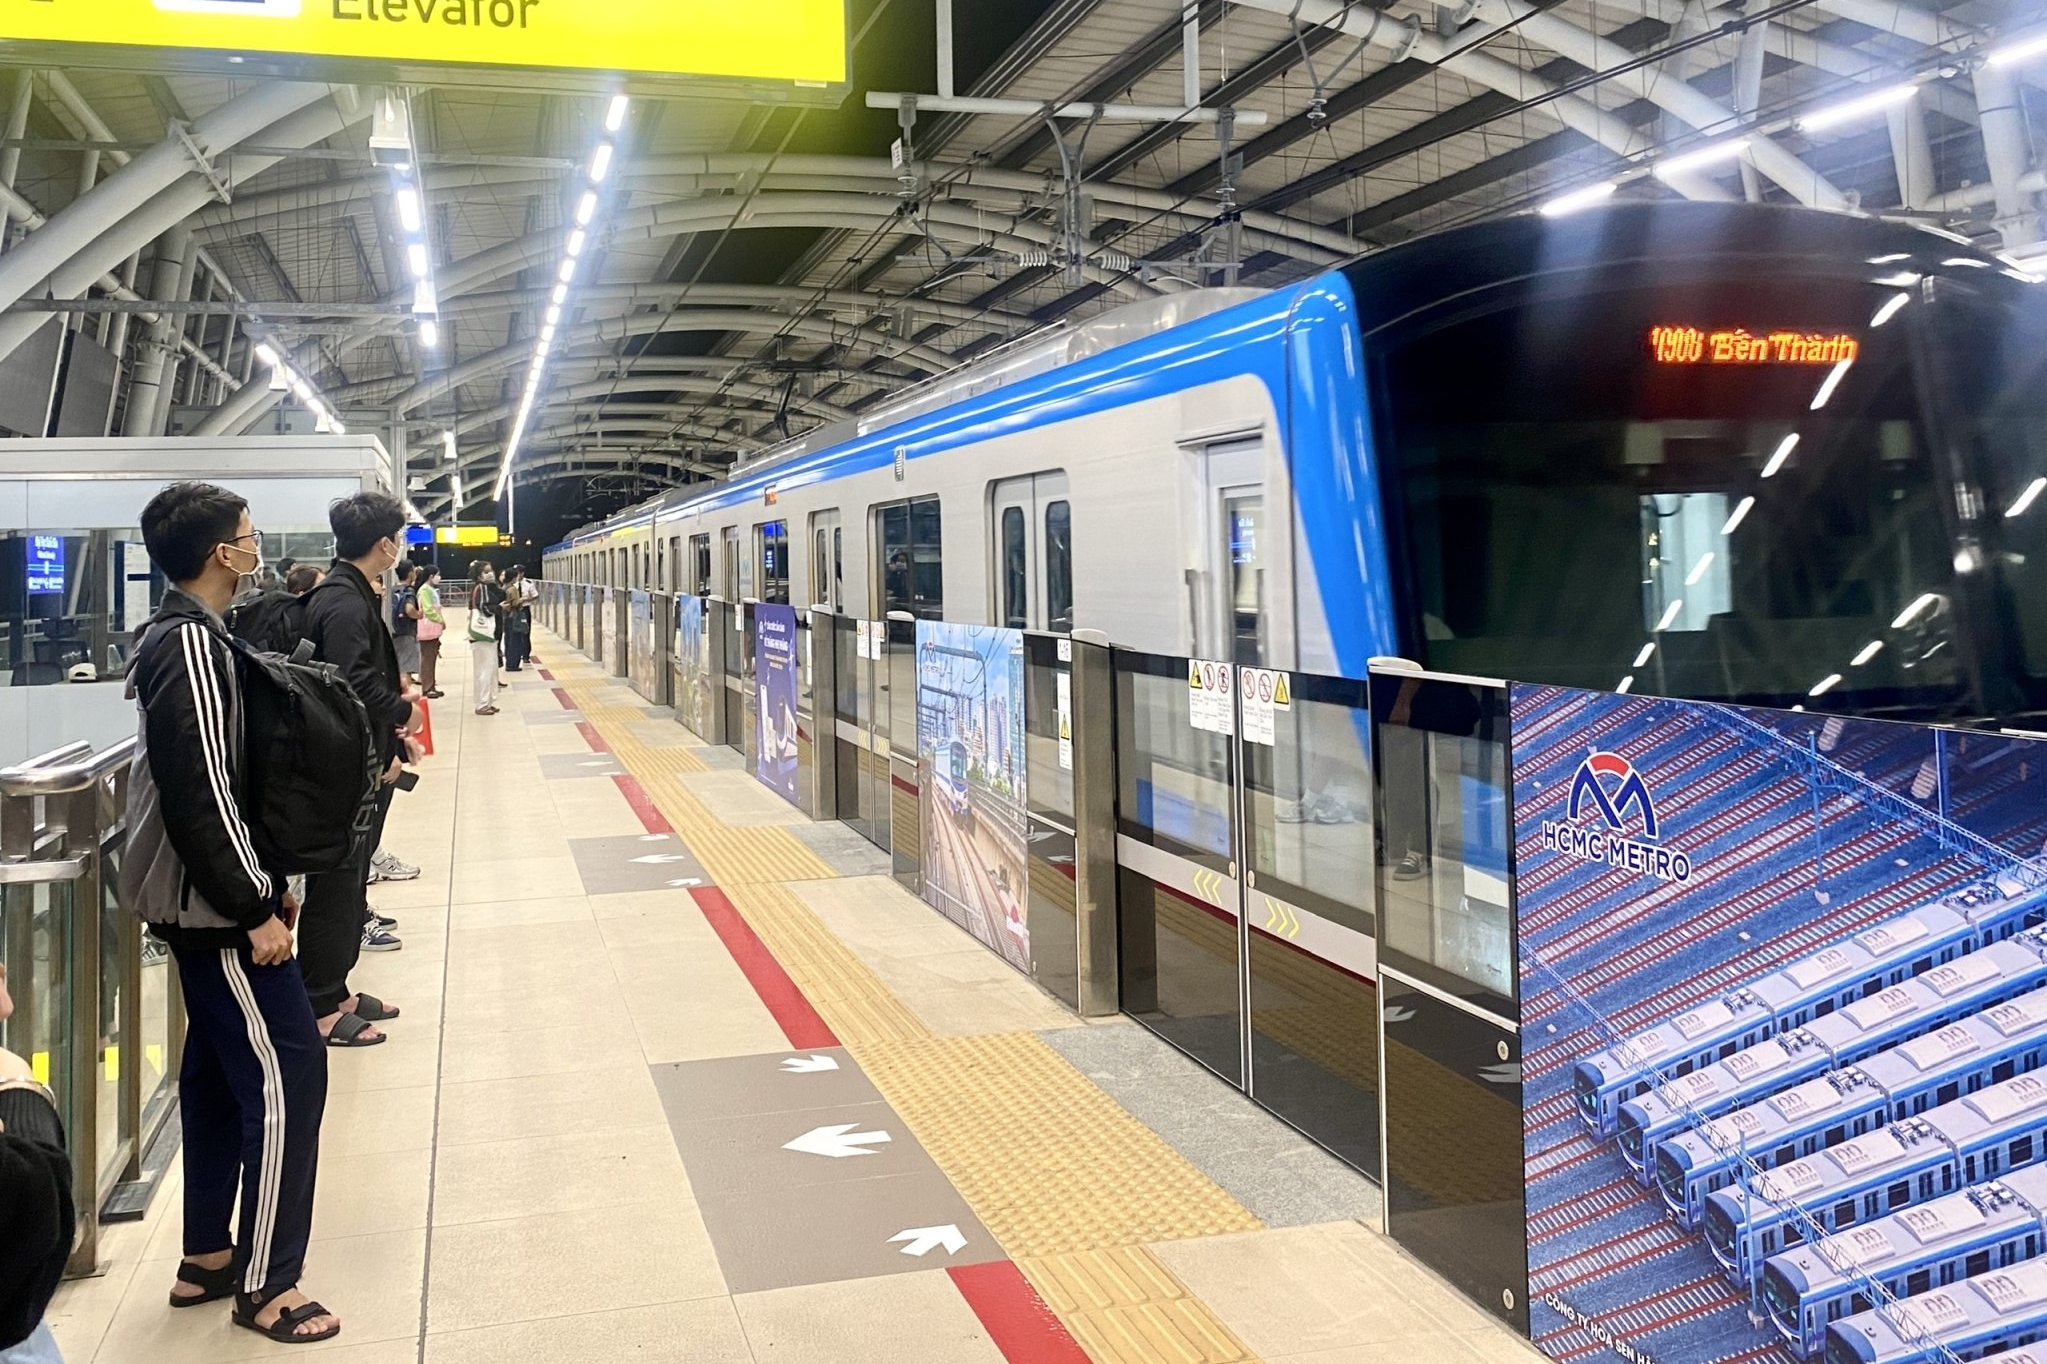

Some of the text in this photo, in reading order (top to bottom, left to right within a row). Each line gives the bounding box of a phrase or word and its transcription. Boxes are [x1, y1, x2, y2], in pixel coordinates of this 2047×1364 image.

[1770, 333, 1857, 361] Thành
[1542, 821, 1691, 882] HCMC METRO
[1591, 1321, 1613, 1348] HOA
[1615, 1339, 1635, 1362] SEN
